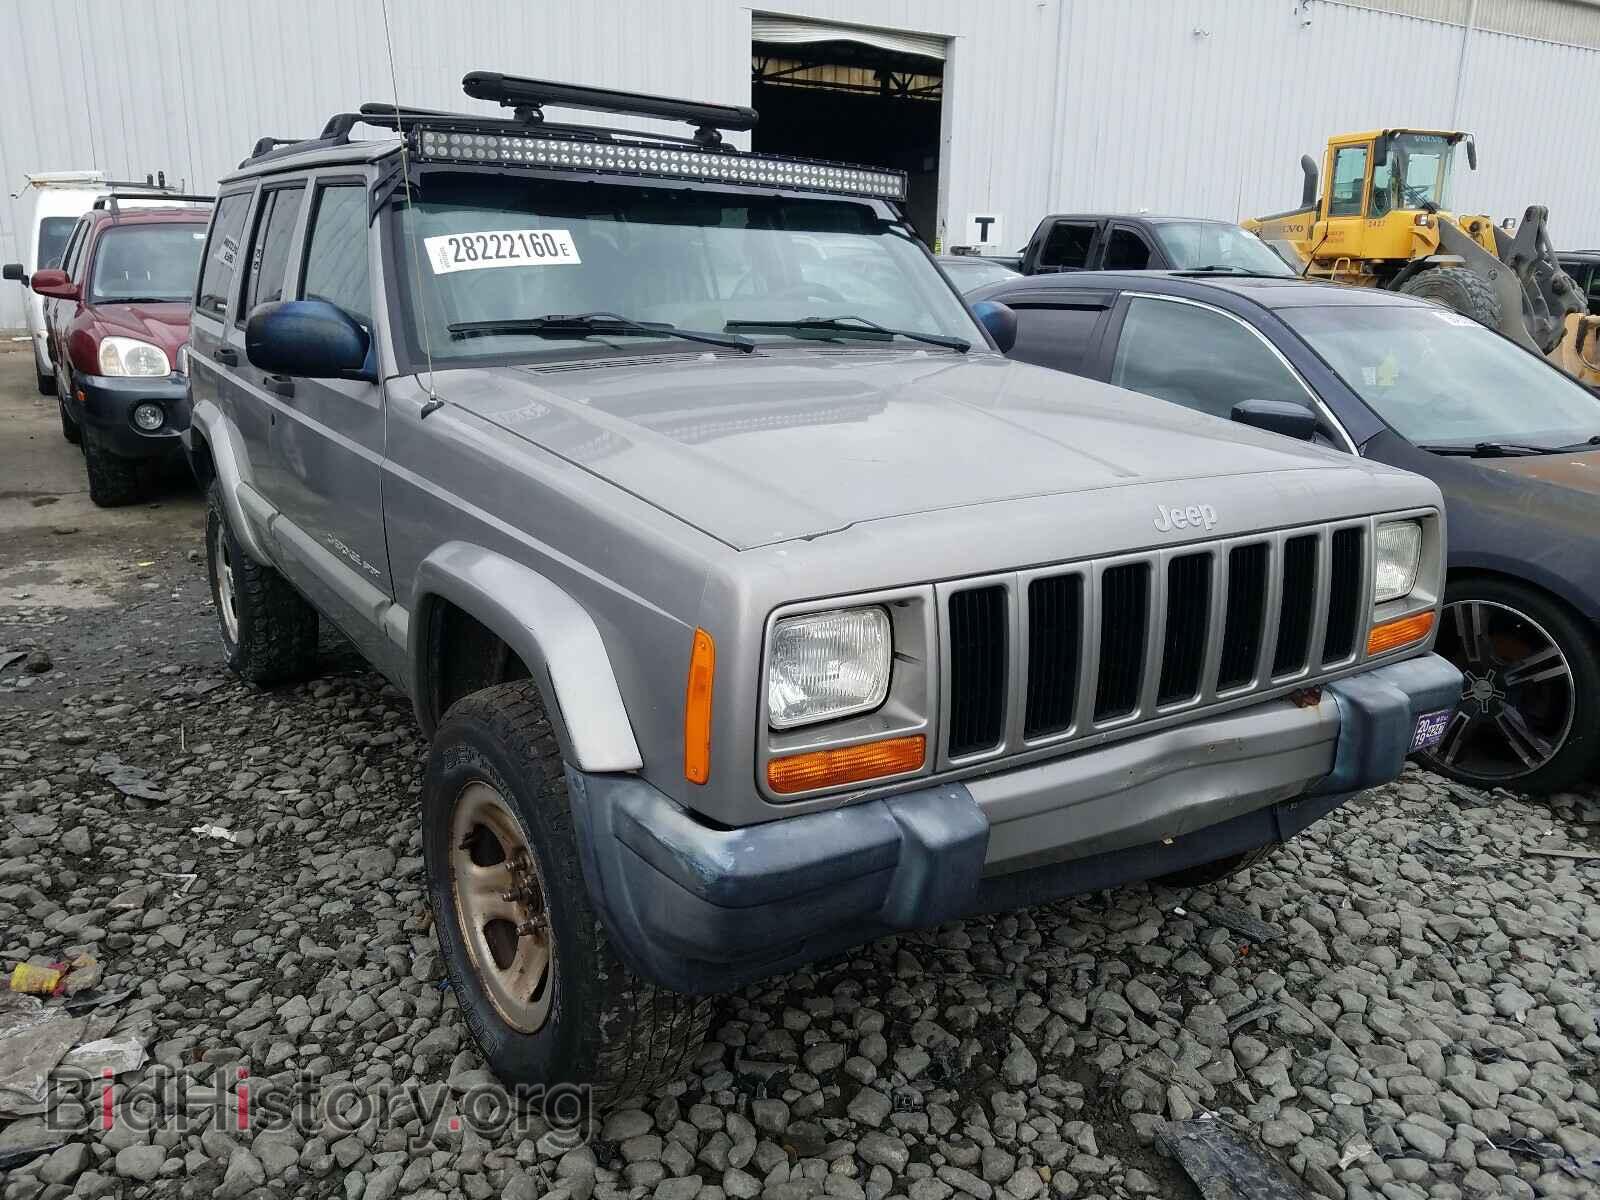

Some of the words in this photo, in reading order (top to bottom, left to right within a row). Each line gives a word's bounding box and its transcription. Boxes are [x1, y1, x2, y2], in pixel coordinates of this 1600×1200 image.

[974, 216, 996, 243] T
[448, 232, 559, 263] 28222160
[560, 243, 570, 256] E
[1152, 503, 1217, 533] Jeep
[1417, 719, 1430, 733] 20
